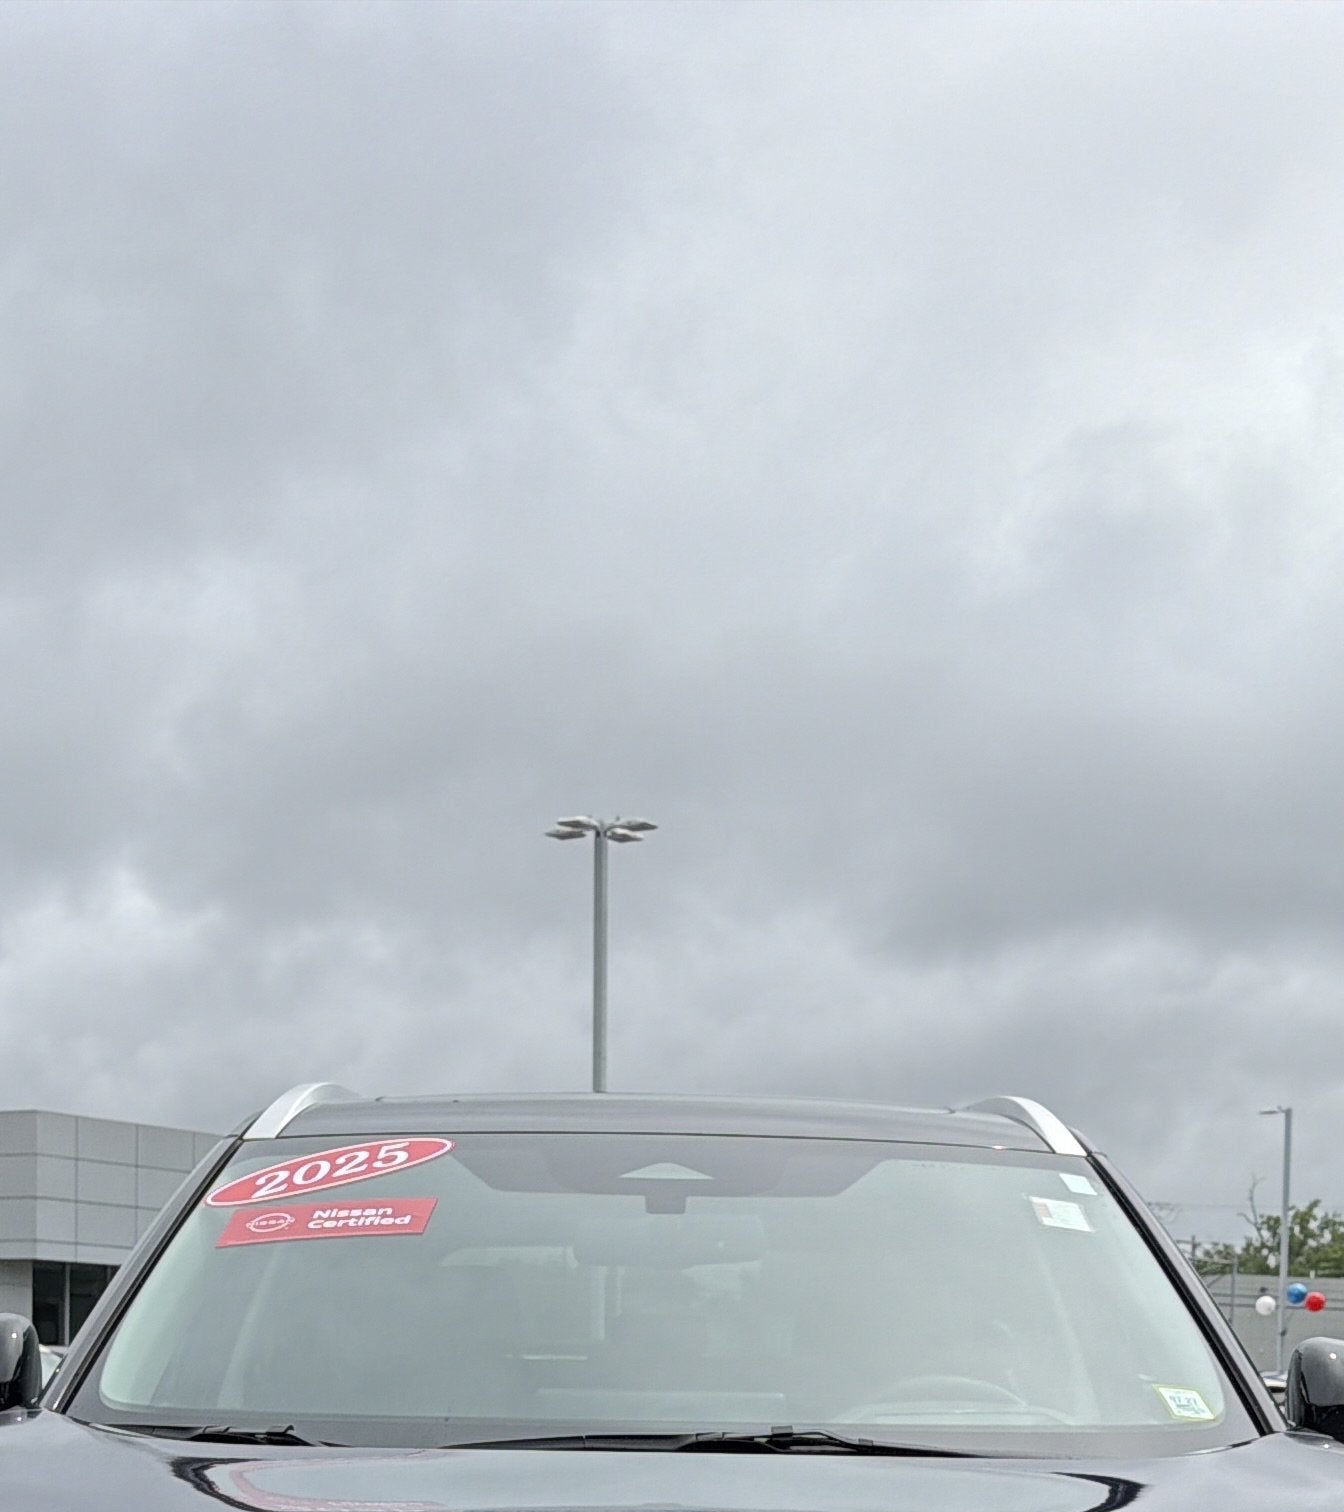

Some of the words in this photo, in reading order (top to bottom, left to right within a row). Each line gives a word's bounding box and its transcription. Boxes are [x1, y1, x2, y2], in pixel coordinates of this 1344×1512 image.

[251, 1141, 410, 1199] 2025
[312, 1207, 393, 1219] Nissan
[307, 1214, 412, 1229] Certified
